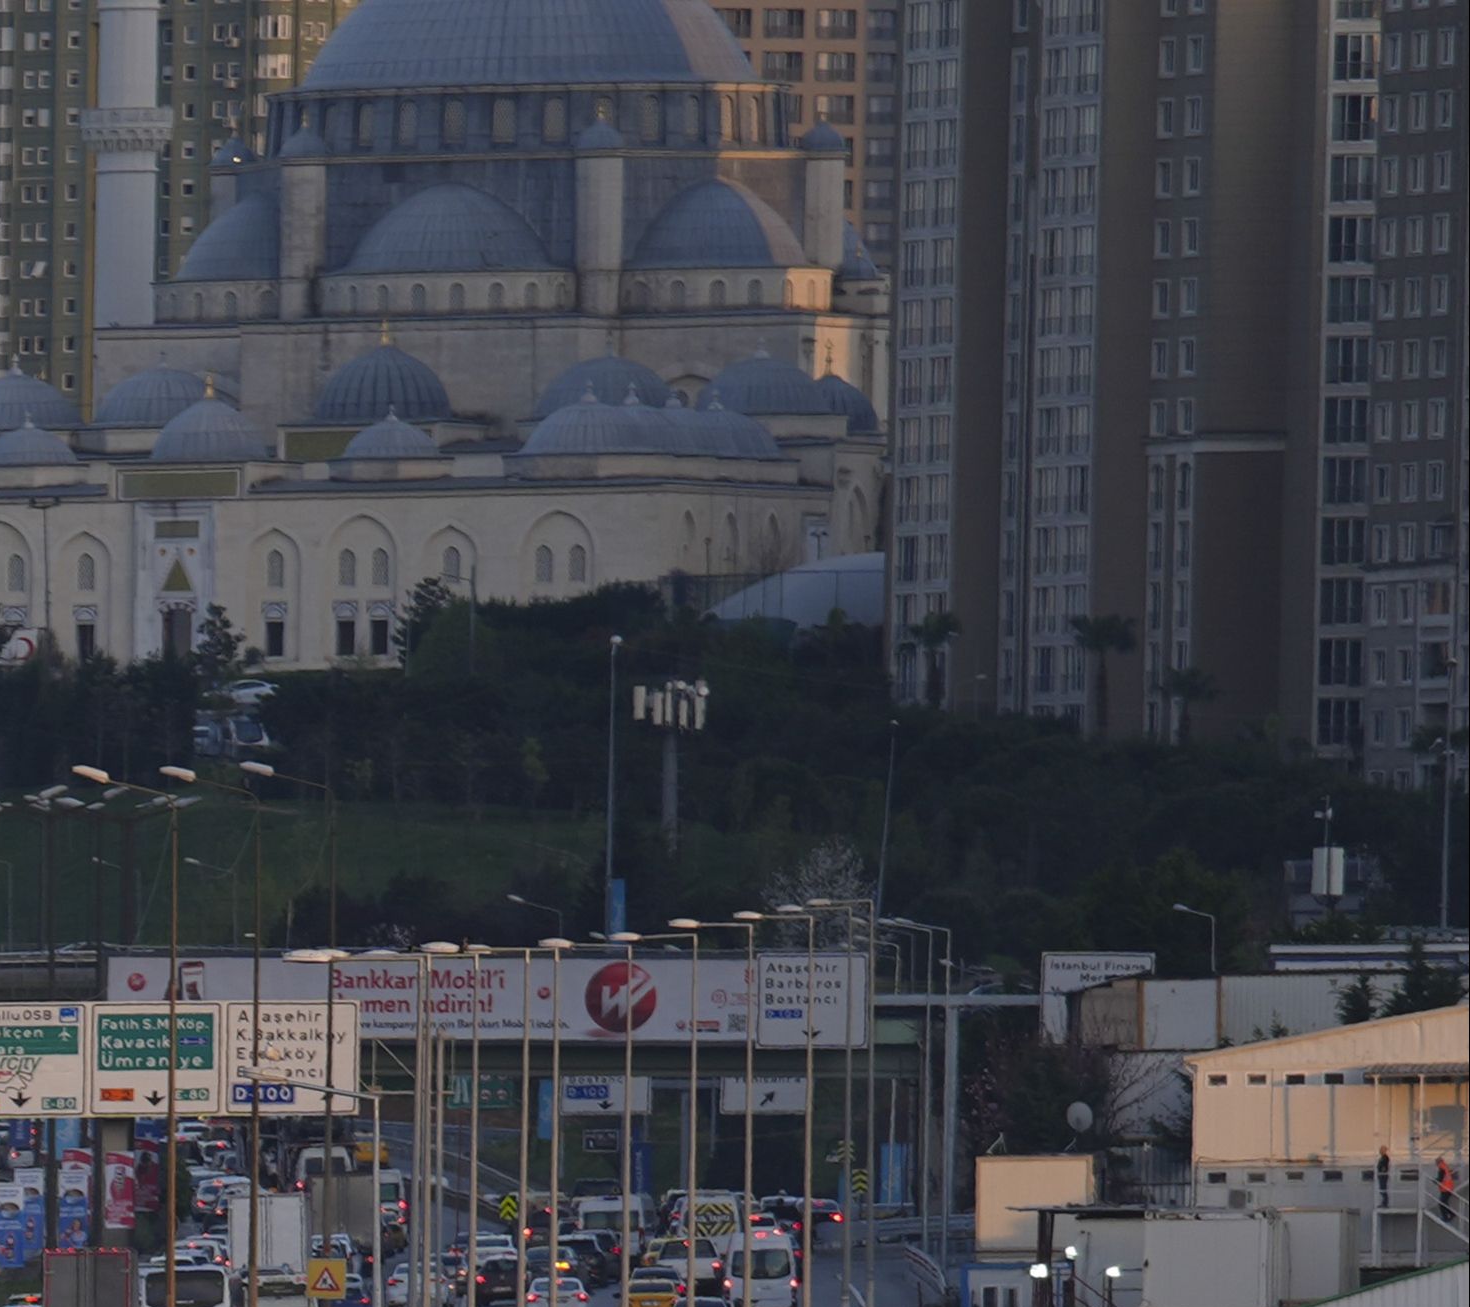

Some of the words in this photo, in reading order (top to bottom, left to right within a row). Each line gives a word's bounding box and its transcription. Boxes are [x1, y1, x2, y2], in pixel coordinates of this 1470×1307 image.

[238, 1009, 323, 1023] Aaşehir
[101, 1018, 140, 1030] Fatih
[101, 1034, 171, 1050] Kavacık
[101, 1051, 205, 1070] Ümranye
